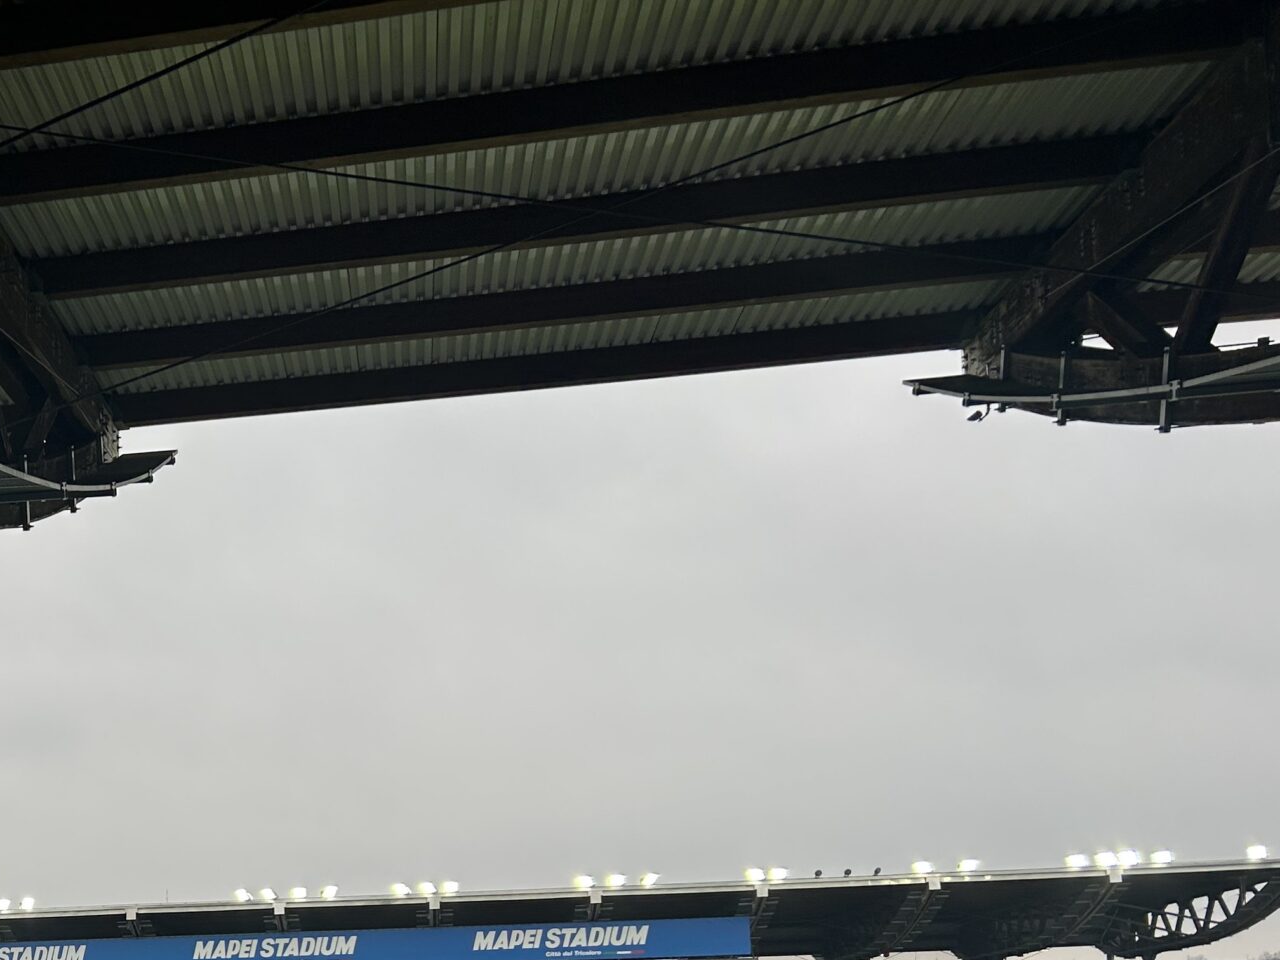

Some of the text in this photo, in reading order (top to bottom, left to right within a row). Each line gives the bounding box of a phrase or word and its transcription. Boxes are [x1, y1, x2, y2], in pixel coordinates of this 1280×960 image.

[193, 936, 357, 960] MAPEI STADIUM
[473, 925, 650, 951] MAPEI STADIUM
